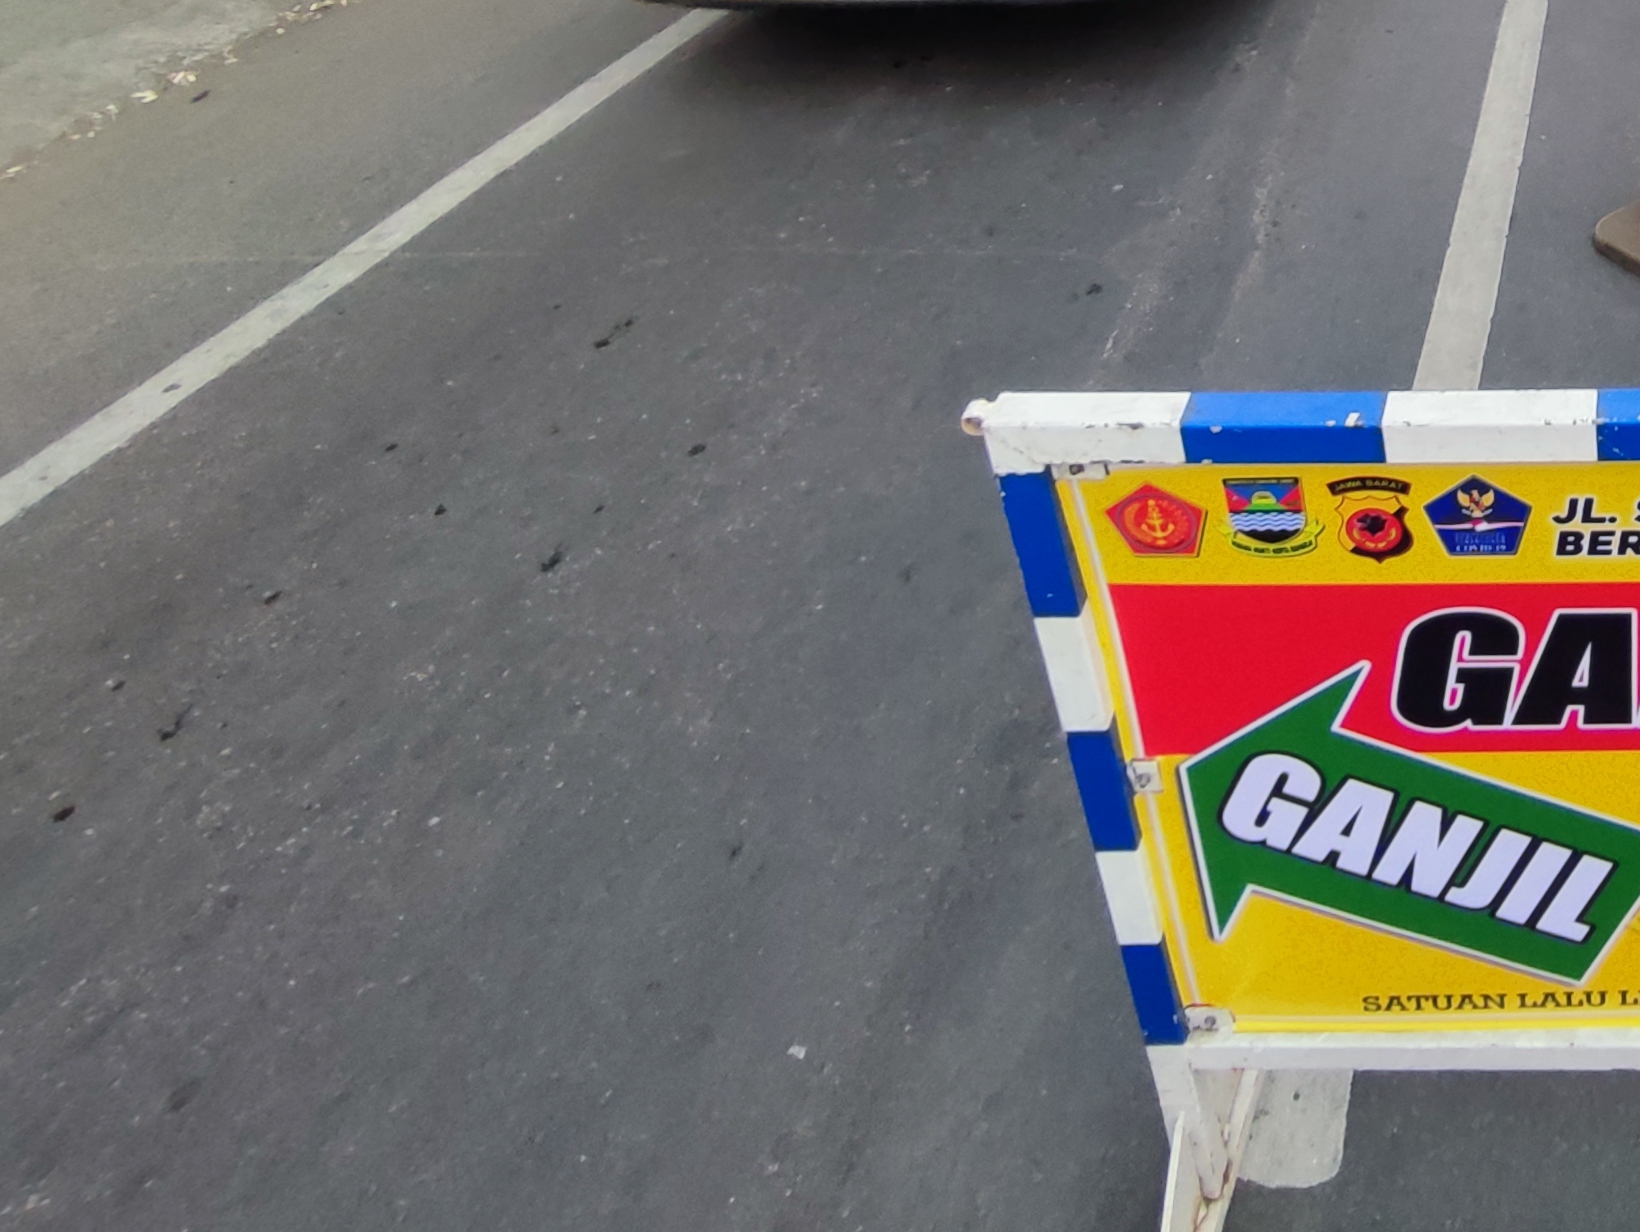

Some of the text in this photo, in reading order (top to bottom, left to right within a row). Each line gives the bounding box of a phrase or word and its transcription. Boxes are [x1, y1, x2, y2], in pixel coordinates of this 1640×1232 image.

[1552, 497, 1618, 524] JL.
[1219, 752, 1617, 945] GANJIL
[1362, 993, 1507, 1012] SATUAN
[1517, 990, 1608, 1008] LALU
